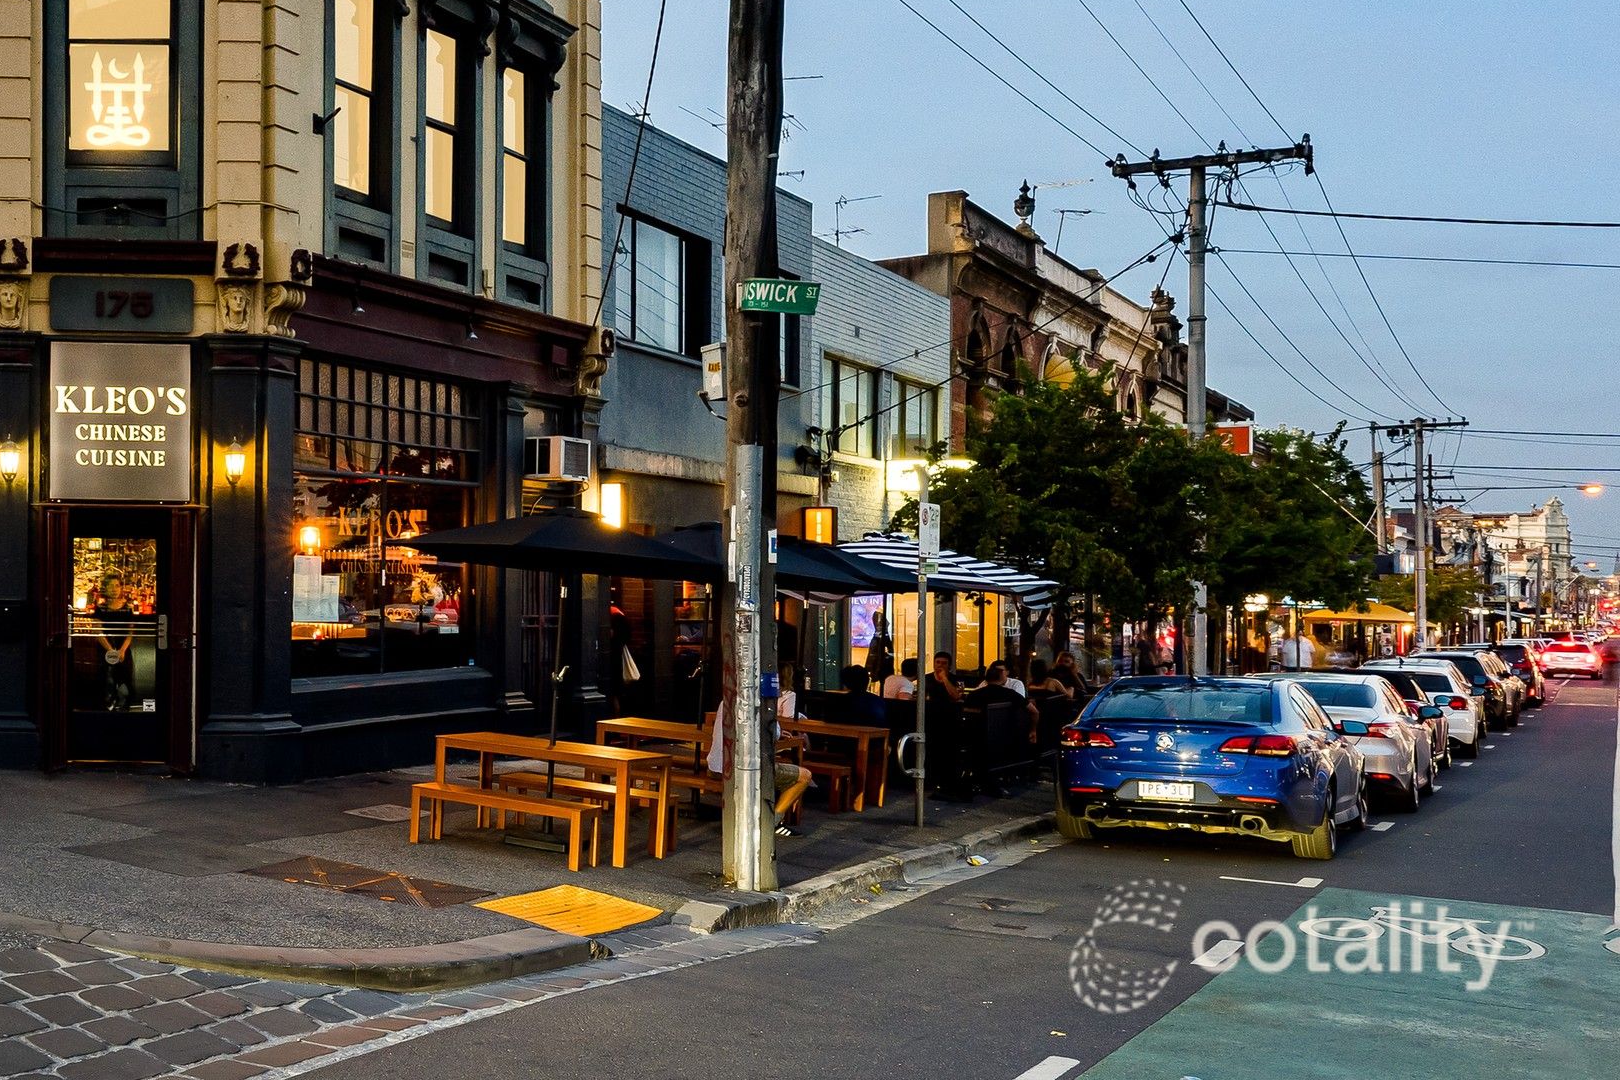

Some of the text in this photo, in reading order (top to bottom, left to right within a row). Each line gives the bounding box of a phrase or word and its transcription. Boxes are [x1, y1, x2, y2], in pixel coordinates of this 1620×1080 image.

[95, 291, 155, 319] 175
[54, 385, 187, 416] KLEO'S
[75, 423, 167, 442] CHINESE
[75, 448, 167, 467] CUISINE
